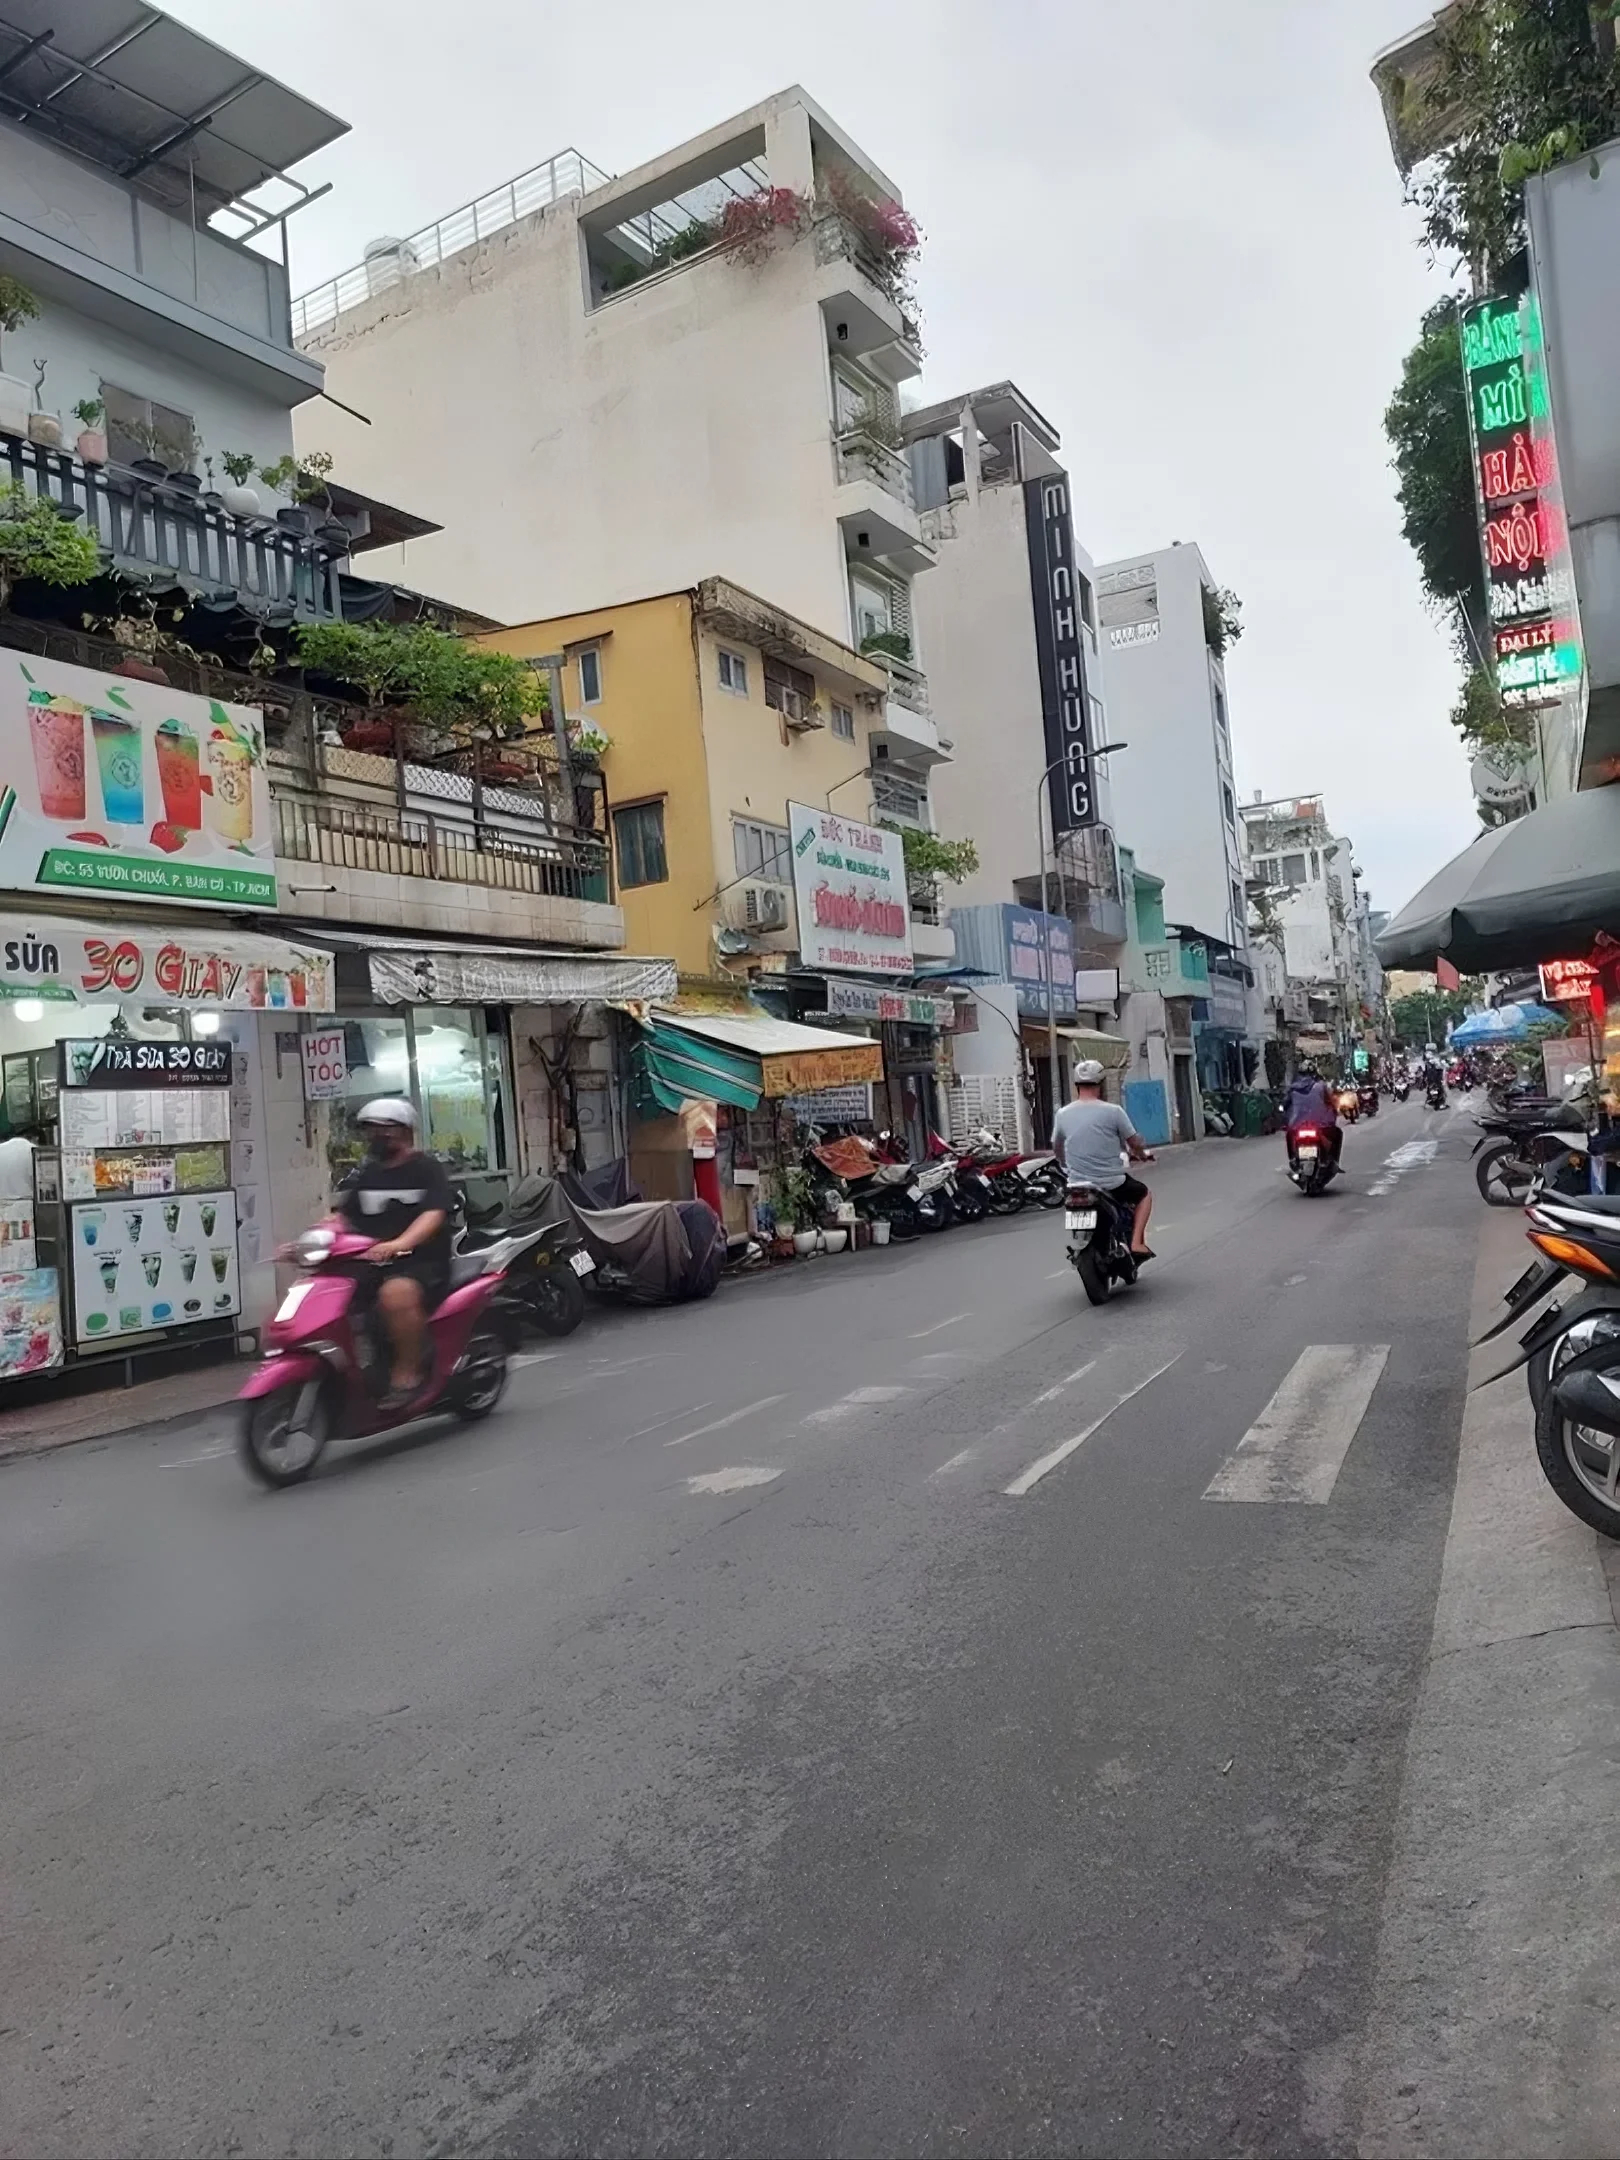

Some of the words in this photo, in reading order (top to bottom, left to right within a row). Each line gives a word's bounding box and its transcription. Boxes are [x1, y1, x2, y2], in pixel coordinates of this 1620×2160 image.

[1484, 433, 1536, 498] HÀ
[1045, 484, 1075, 641] MINH
[5, 932, 59, 974] SỮA
[81, 938, 145, 994] 30
[168, 1046, 191, 1069] 30
